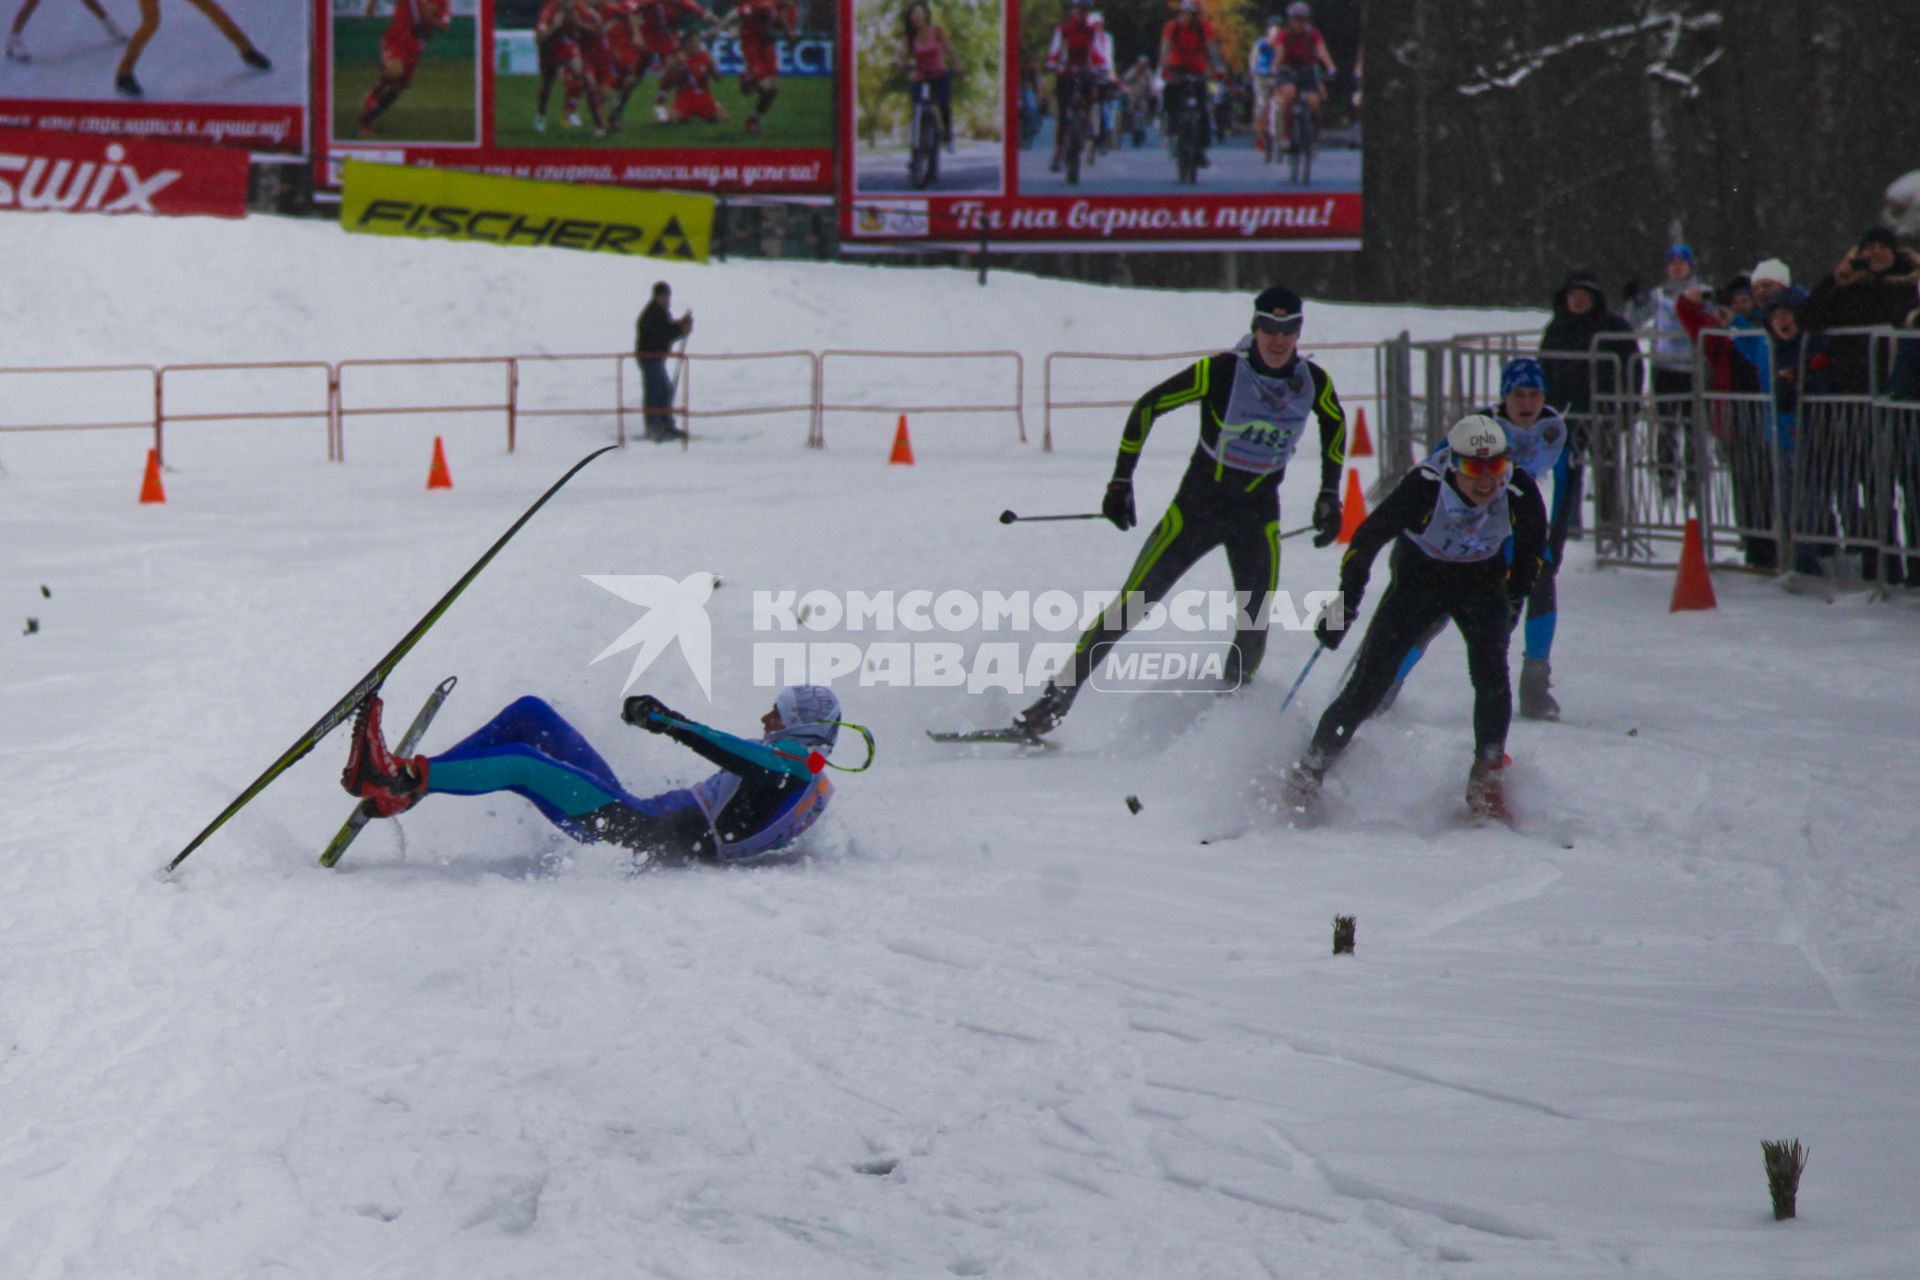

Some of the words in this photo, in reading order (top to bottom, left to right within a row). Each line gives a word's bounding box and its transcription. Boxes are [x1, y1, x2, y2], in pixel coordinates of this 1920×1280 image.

[621, 164, 739, 186] максимум
[741, 160, 820, 186] успеха!
[358, 198, 644, 252] FISCHER
[952, 201, 1004, 230] Ты
[1010, 207, 1062, 230] на
[1067, 199, 1210, 237] верном
[1215, 199, 1336, 236] пути!
